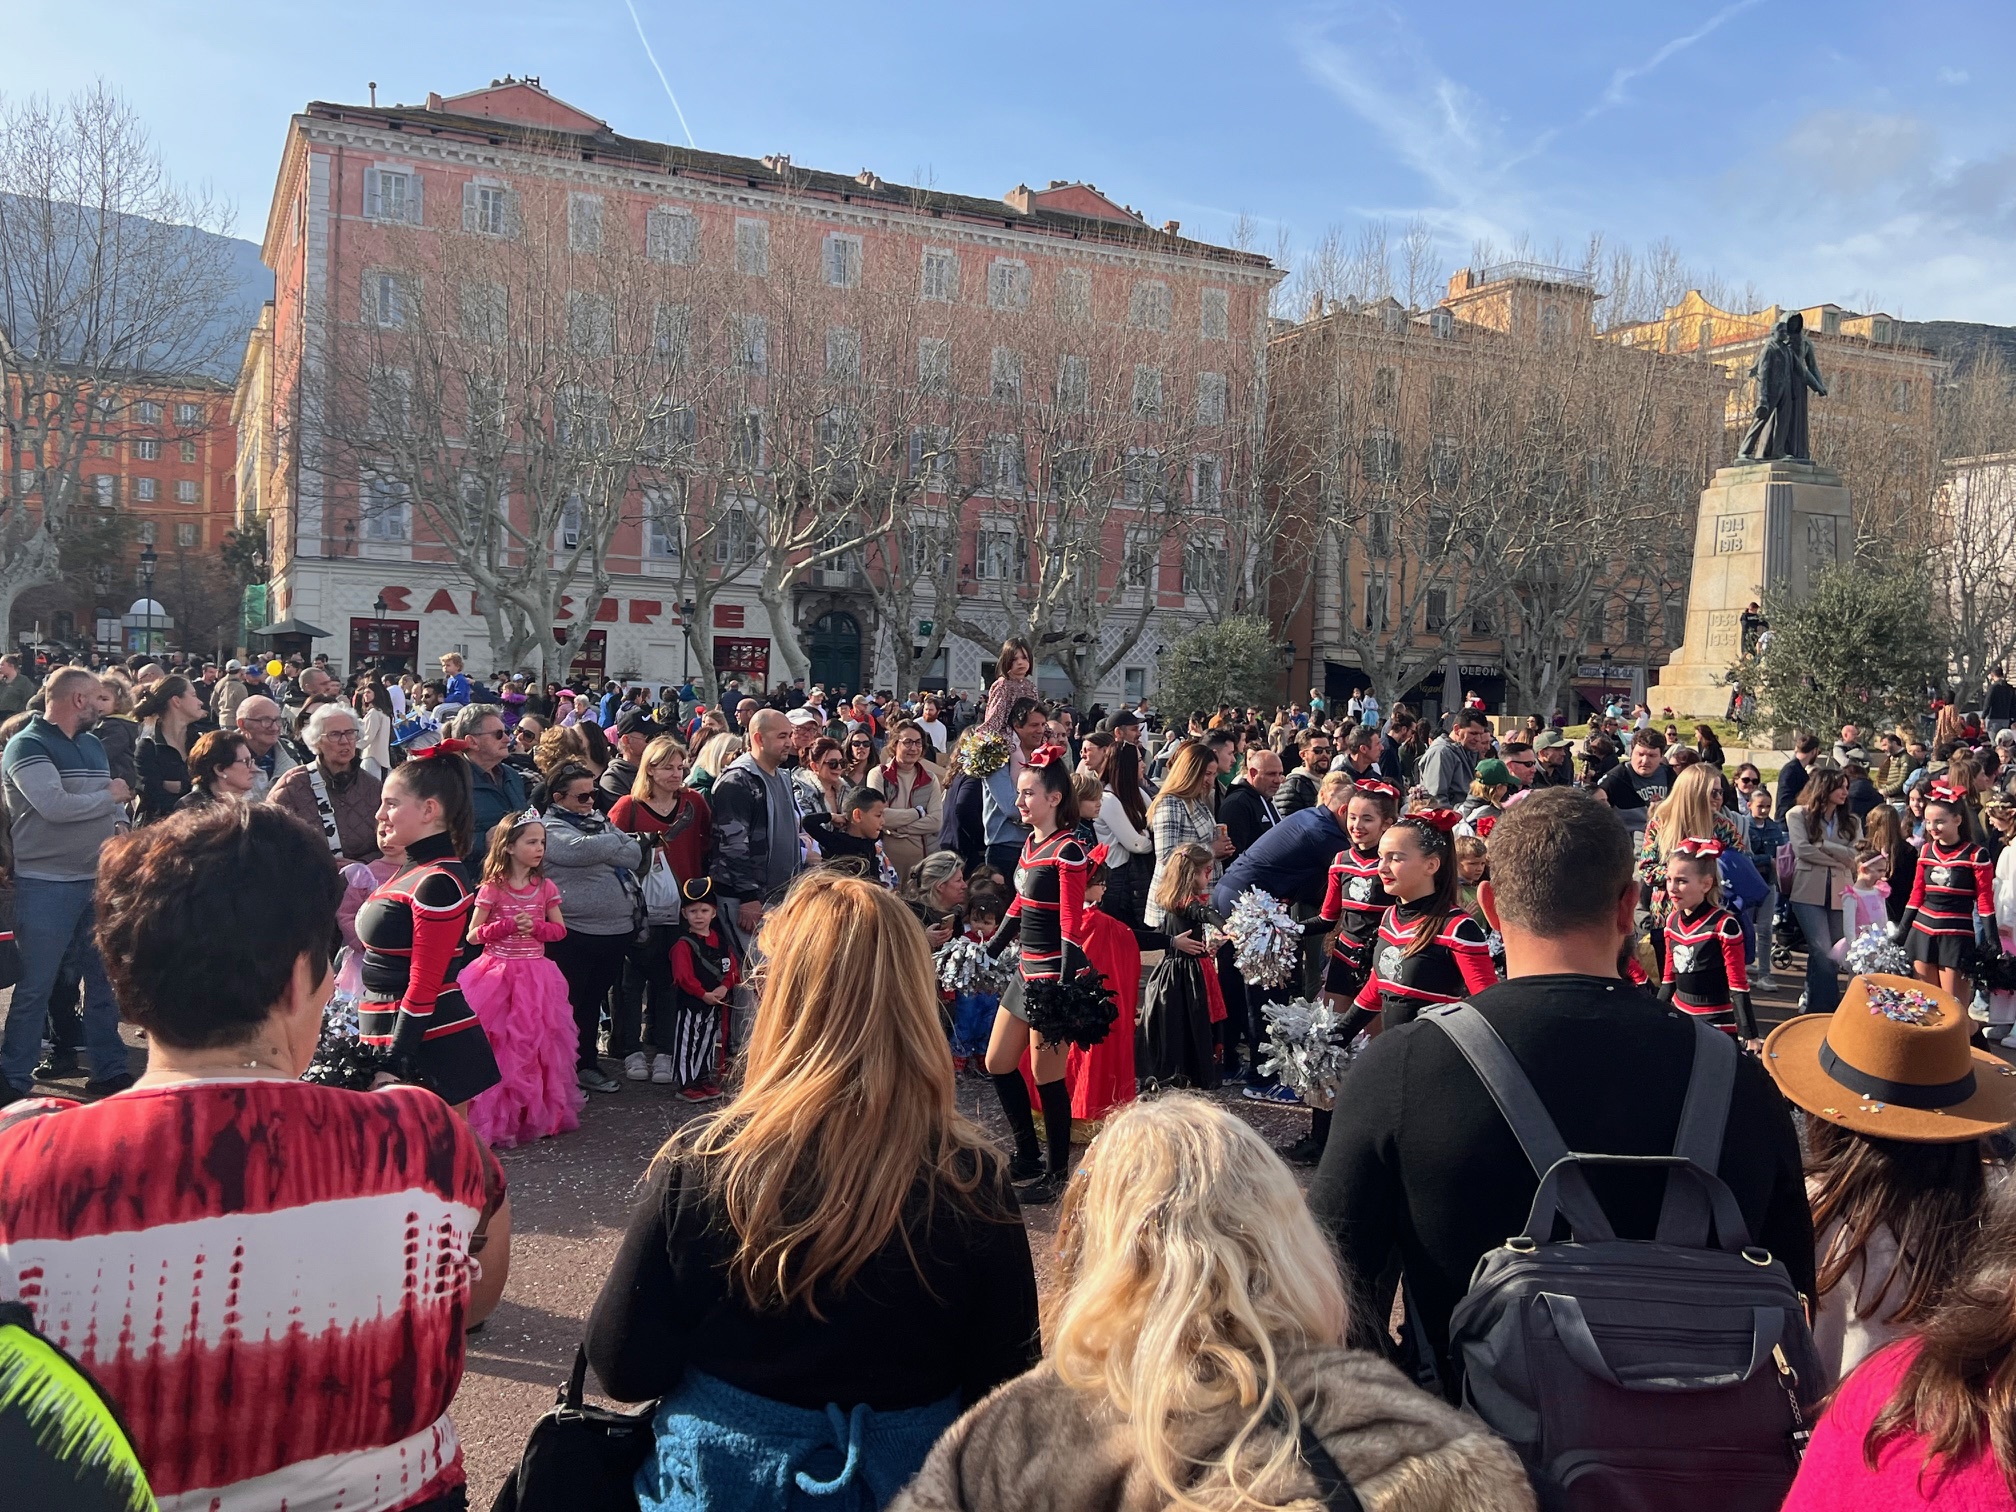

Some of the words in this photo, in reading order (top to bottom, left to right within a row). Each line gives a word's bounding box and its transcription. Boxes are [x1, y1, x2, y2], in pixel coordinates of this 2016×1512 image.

[1720, 517, 1744, 532] 1914
[1719, 538, 1743, 553] 1918
[1709, 613, 1738, 627] 1939
[1709, 632, 1737, 647] 1945
[1437, 665, 1498, 677] NOLEON
